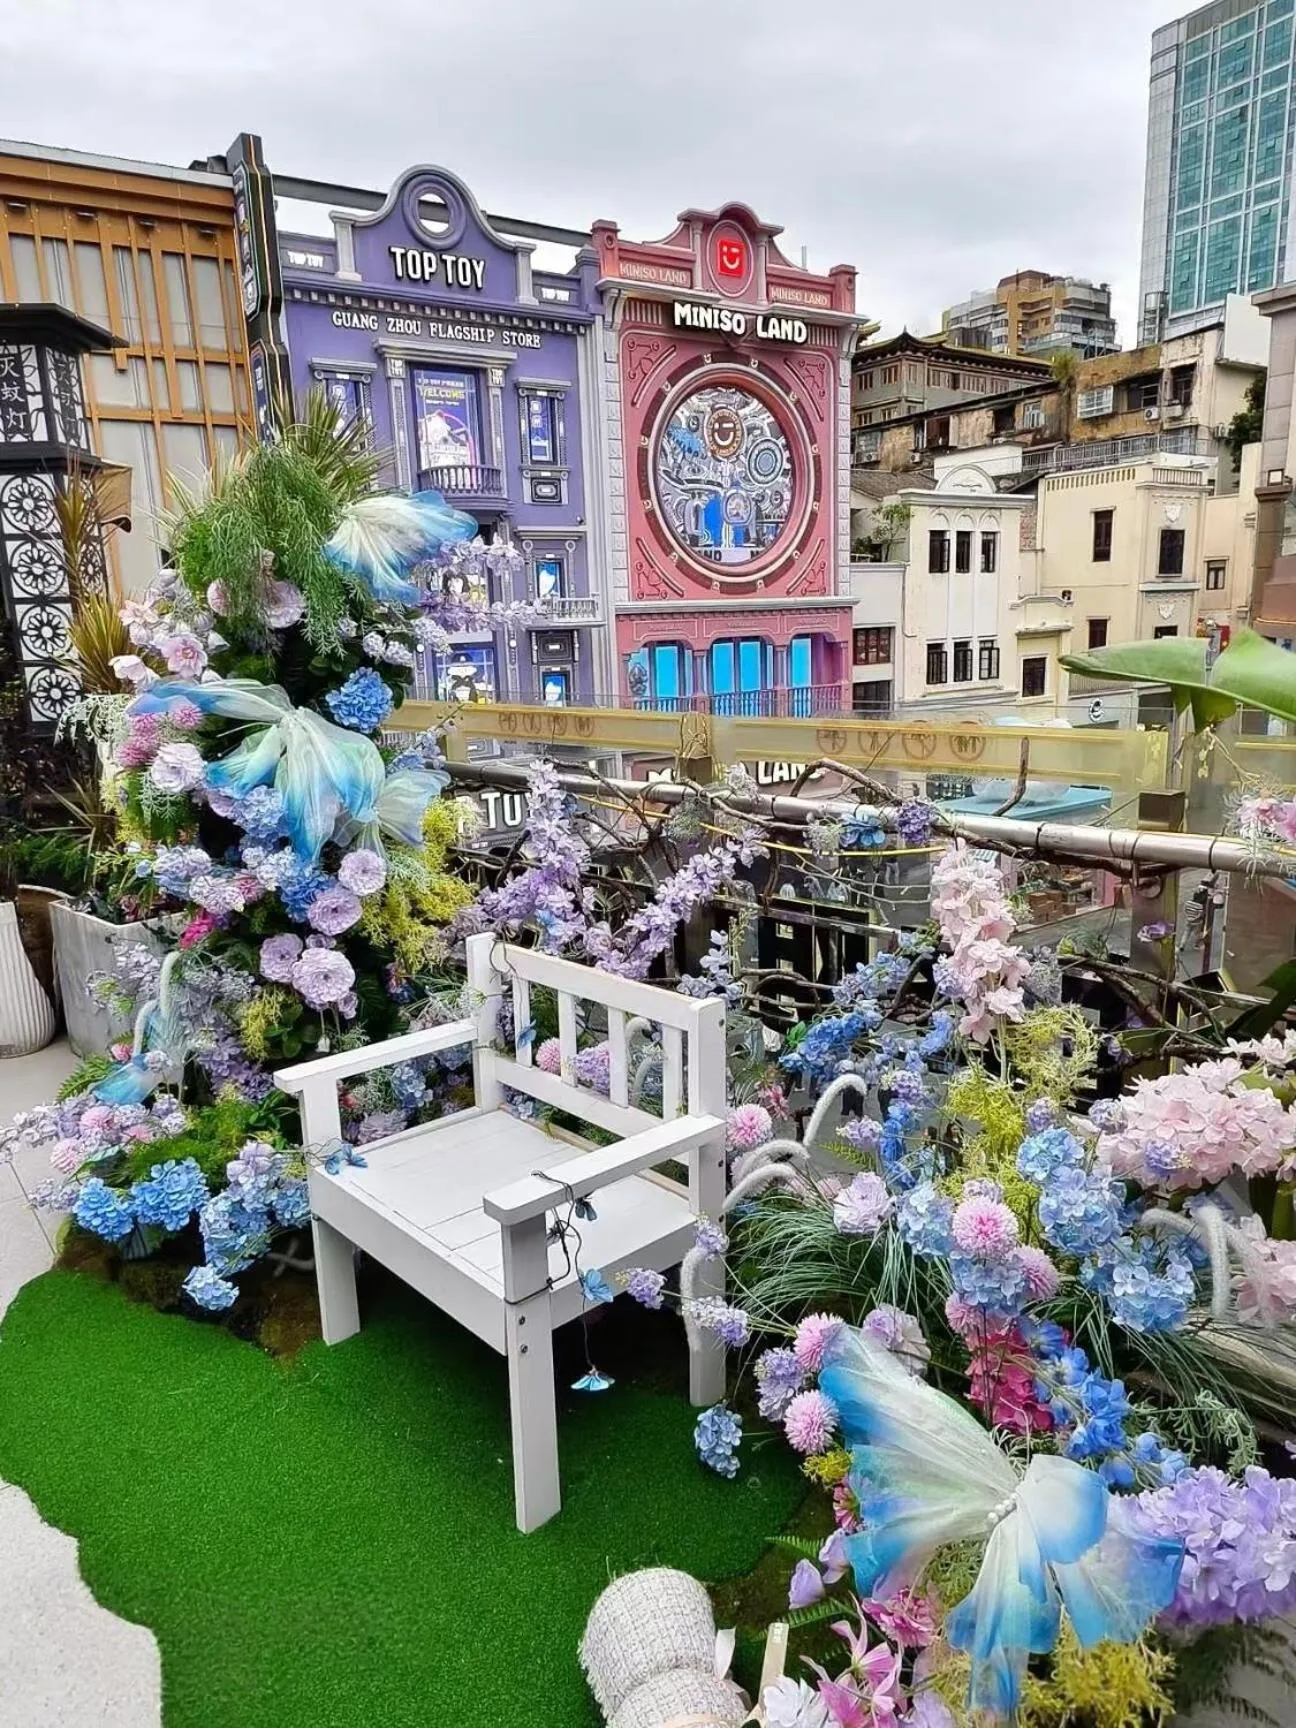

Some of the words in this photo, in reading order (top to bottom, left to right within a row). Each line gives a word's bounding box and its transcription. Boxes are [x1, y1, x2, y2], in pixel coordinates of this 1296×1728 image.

[390, 246, 437, 281] TOP
[441, 254, 485, 289] TOY
[620, 262, 656, 281] MINISO
[659, 267, 688, 284] LAND
[771, 286, 801, 302] MINISO
[803, 292, 829, 306] LAND
[332, 311, 379, 330] GUANG
[387, 317, 422, 336] ZHOU
[429, 322, 495, 344] FLAGSHIP
[502, 330, 542, 349] STORE
[674, 301, 747, 335] MINISO
[756, 315, 807, 344] LAND
[0, 356, 27, 430] 灭蚊灯
